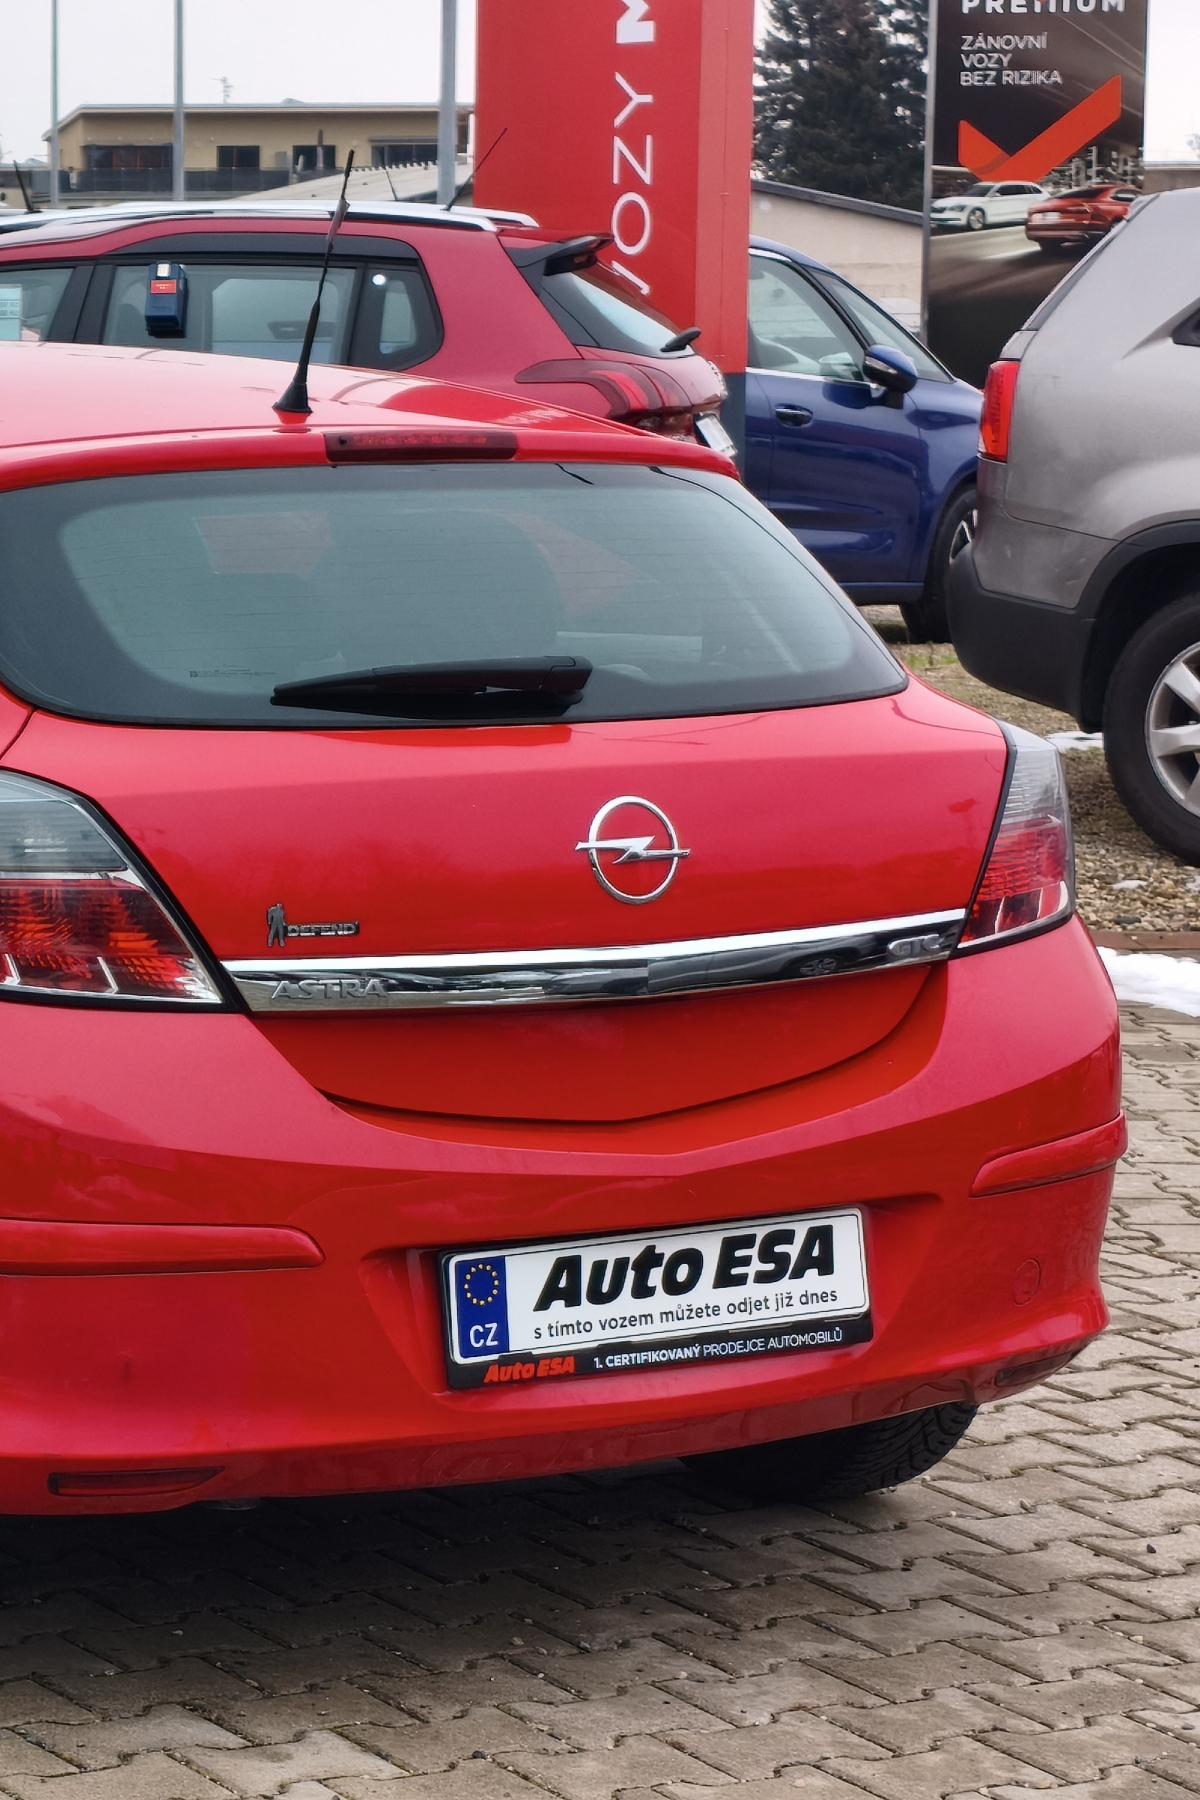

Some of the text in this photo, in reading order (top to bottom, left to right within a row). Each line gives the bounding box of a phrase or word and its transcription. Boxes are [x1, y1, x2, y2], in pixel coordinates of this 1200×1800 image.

[960, 32, 1048, 51] ZÁNOVNÍ
[960, 53, 1012, 69] VOZY
[959, 70, 1063, 87] BEZ RIZIKA
[287, 921, 360, 938] DEFEND
[271, 978, 388, 1001] ASTRA
[532, 1224, 835, 1313] Auto ESA
[533, 1287, 839, 1340] s tímto vozem můžete odjet již dnes
[468, 1322, 499, 1349] CZ
[593, 1325, 844, 1370] 1. CERTIFIKOVANÝ PRODEJCE AUTOMOBILŮ
[483, 1355, 576, 1384] Auto ESA
